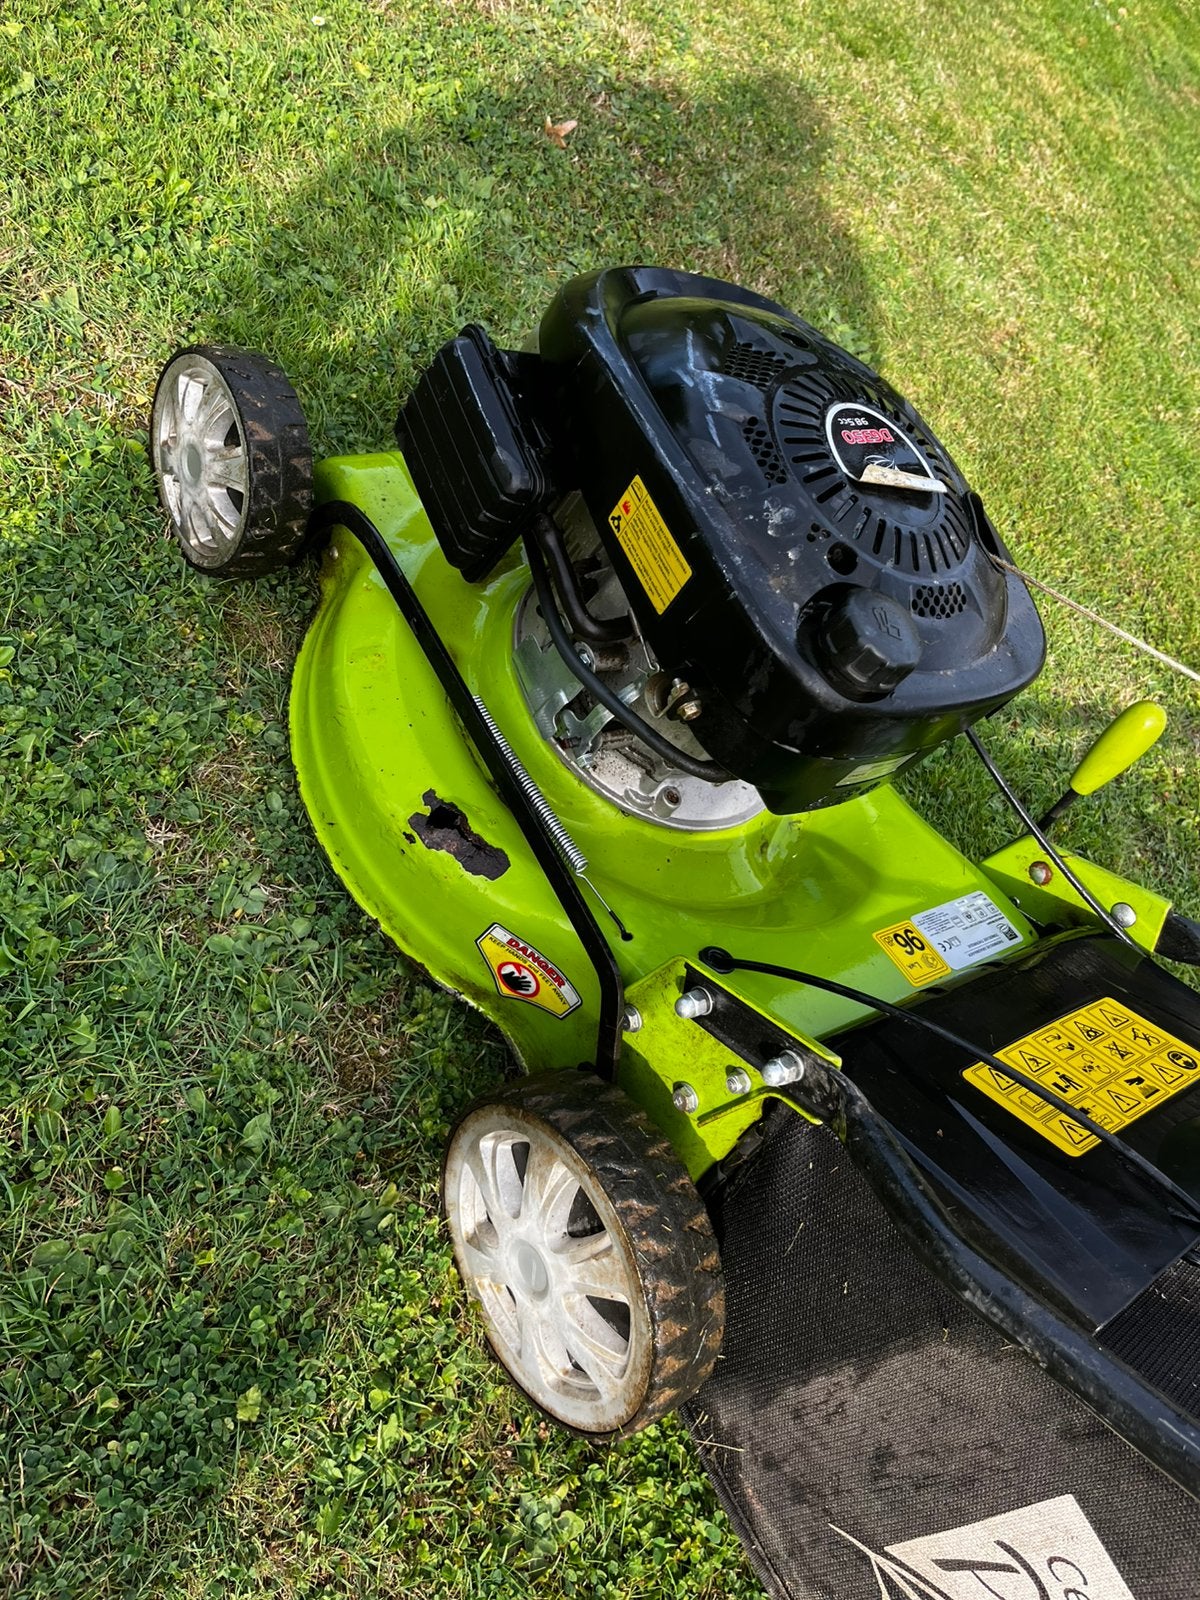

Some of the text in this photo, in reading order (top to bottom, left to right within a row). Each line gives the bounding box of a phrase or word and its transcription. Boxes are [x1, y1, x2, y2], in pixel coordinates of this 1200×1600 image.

[838, 417, 869, 426] 98.5cc
[841, 428, 895, 444] DG350
[893, 928, 926, 956] 96
[489, 936, 568, 1006] KEEP HANDS and FEET AWAY
[506, 938, 566, 989] DANGER
